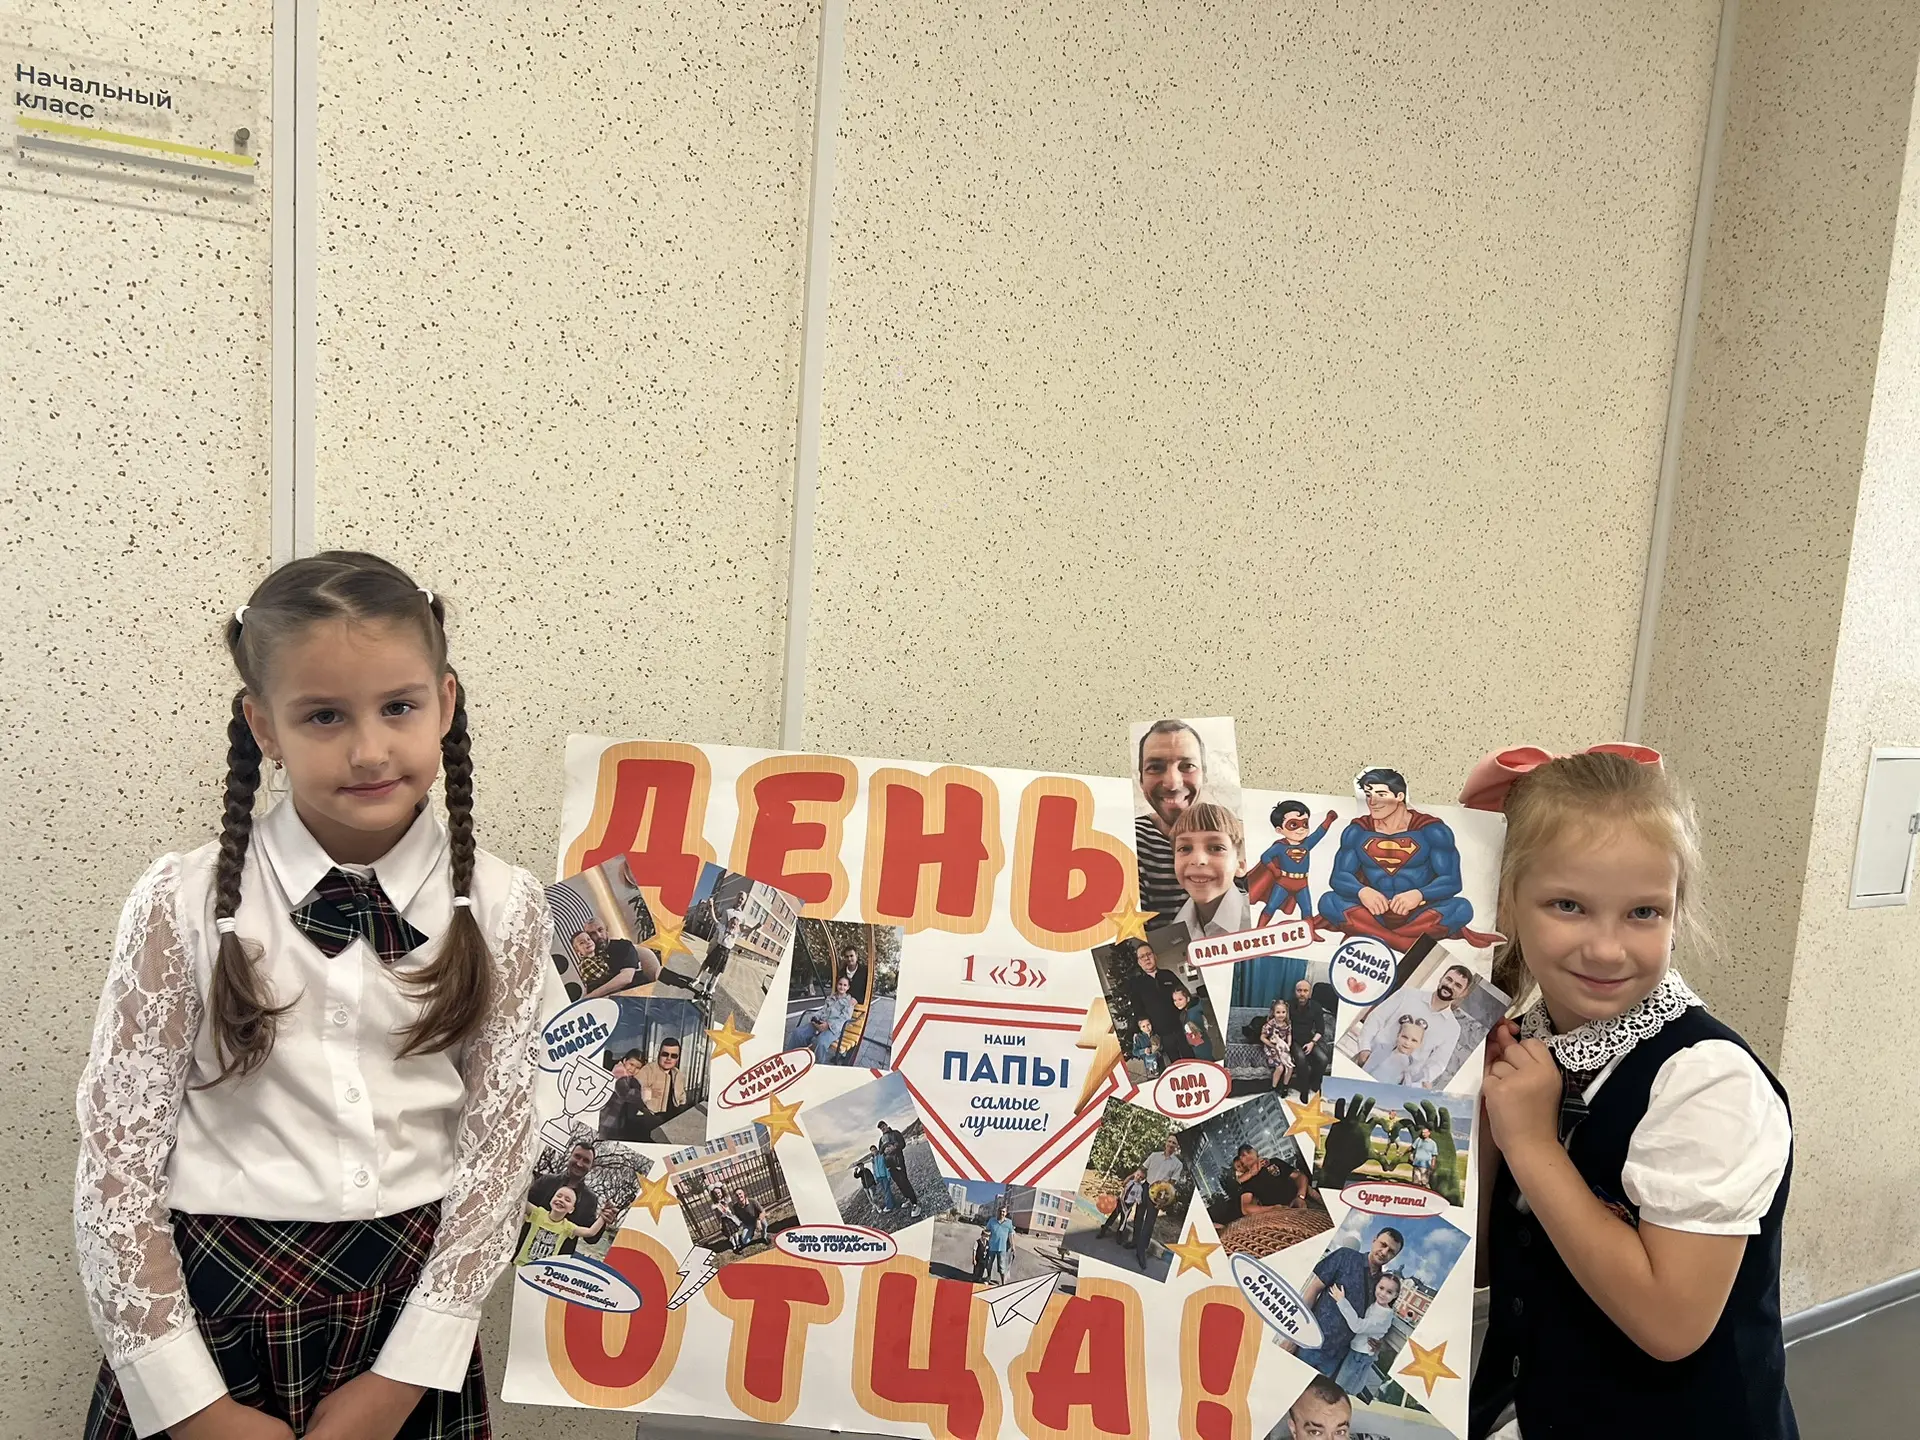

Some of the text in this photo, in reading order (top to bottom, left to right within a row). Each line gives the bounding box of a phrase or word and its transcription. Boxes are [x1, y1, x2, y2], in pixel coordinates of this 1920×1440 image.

[16, 63, 172, 109] Начальный
[15, 92, 95, 118] класс
[578, 757, 1127, 935] ДЕНЬ
[1195, 926, 1306, 960] ПАПА МОЖЕТ ВСЁ
[963, 954, 976, 983] 1
[1337, 955, 1391, 986] РОДНОЙ!
[1345, 945, 1391, 972] САМЫЙ
[545, 1012, 597, 1045] ВСЕГДА
[548, 1022, 609, 1062] ПОМОЖЕТ
[984, 1033, 1026, 1047] НАШИ
[738, 1056, 784, 1086] САМЫЙ
[739, 1063, 797, 1100] МУДРЫЙ!
[942, 1050, 1070, 1089] ПАПЫ
[1169, 1072, 1207, 1092] ПАПА
[970, 1094, 1041, 1112] самые
[1175, 1089, 1211, 1109] КРУТ
[959, 1112, 1049, 1138] лучшие!
[1357, 1189, 1427, 1208] Супер папа!
[785, 1231, 819, 1244] Быть
[797, 1242, 822, 1253] ЭТО
[543, 1265, 570, 1284] День
[1242, 1275, 1300, 1335] СИЛЬНЫЙ!
[1258, 1274, 1299, 1317] САМЫЙ
[563, 1246, 1246, 1440] ОТЦА!
